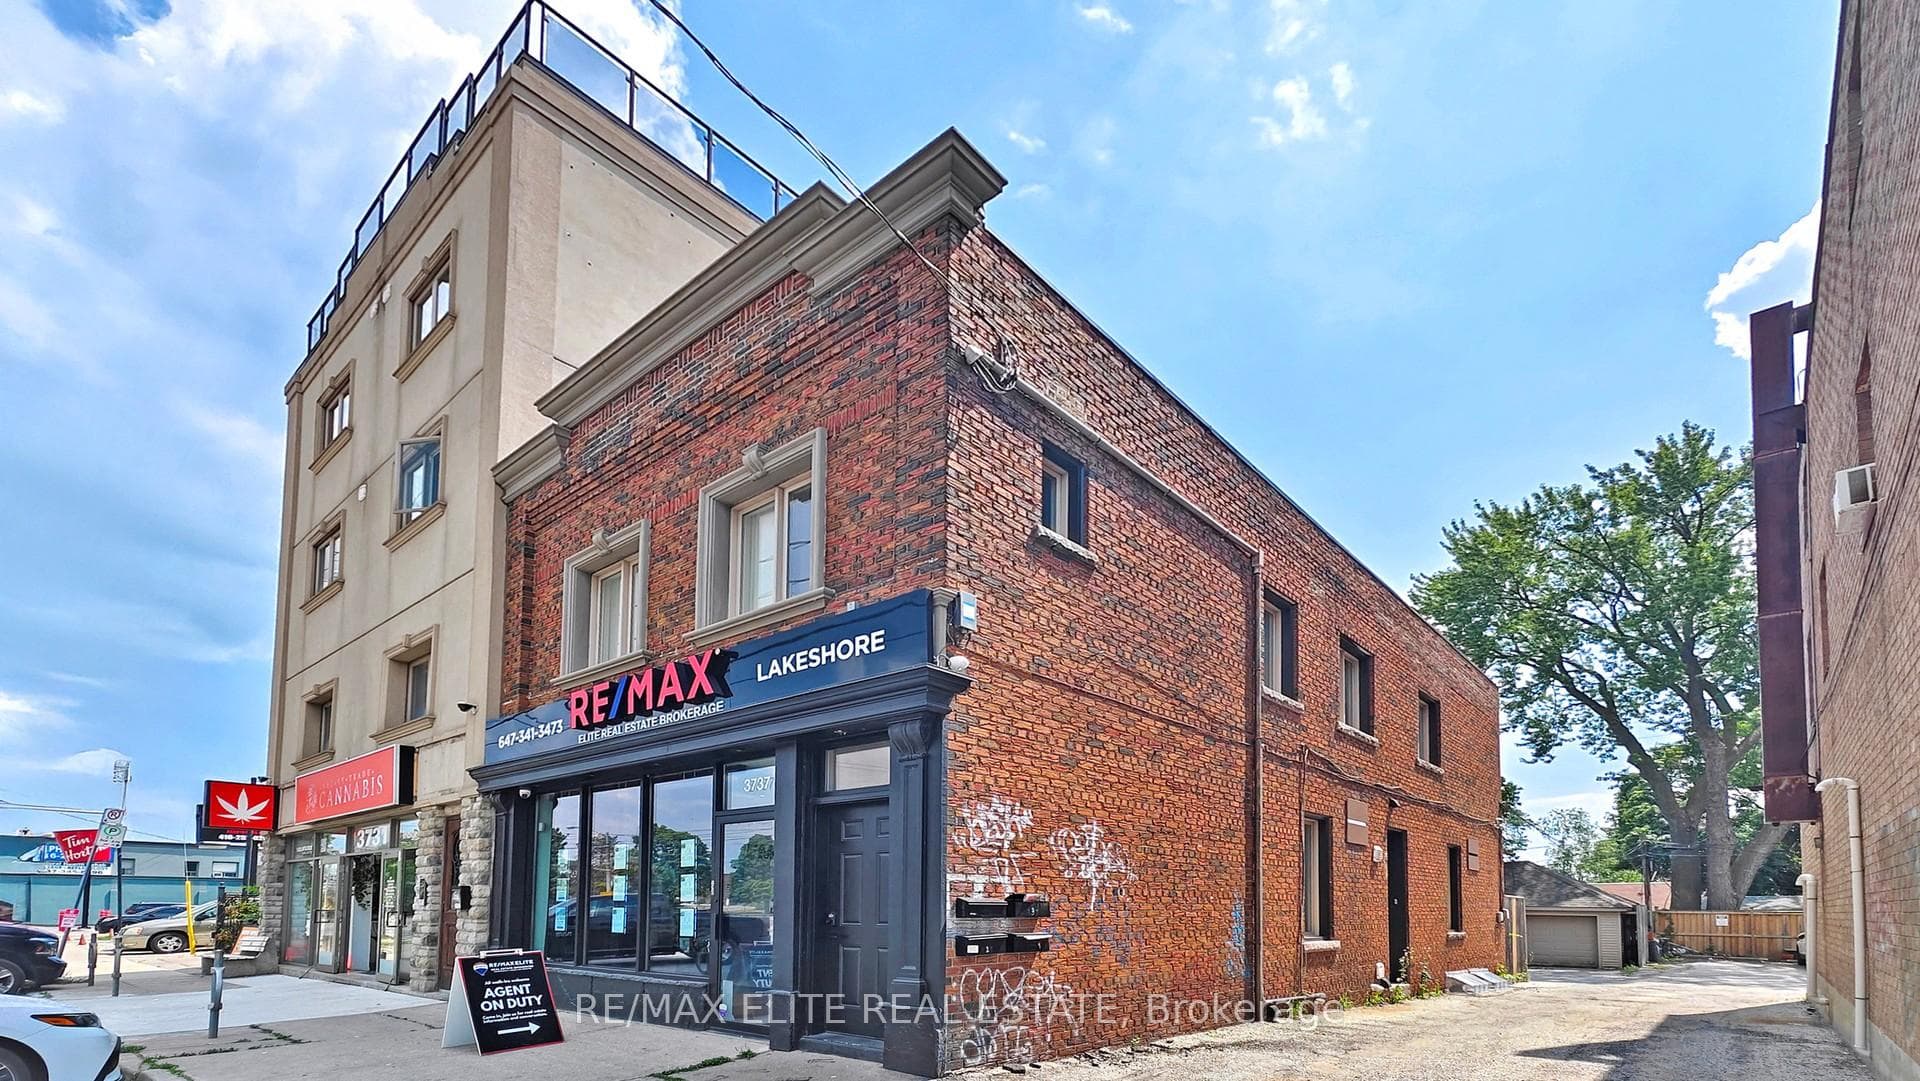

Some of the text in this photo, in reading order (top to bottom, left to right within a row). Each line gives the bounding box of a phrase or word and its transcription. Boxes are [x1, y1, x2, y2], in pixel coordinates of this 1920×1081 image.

[756, 629, 886, 682] LAKESHORE
[569, 649, 715, 729] RE/MAX
[498, 718, 564, 749] 647-341-3473
[578, 700, 724, 744] ELITE REAL ESTATE BROKERAGE
[319, 774, 383, 809] CANNABIS
[743, 776, 770, 792] 3737
[62, 835, 90, 849] Tim
[480, 994, 543, 1011] ON DUTY
[484, 983, 531, 998] AGENT
